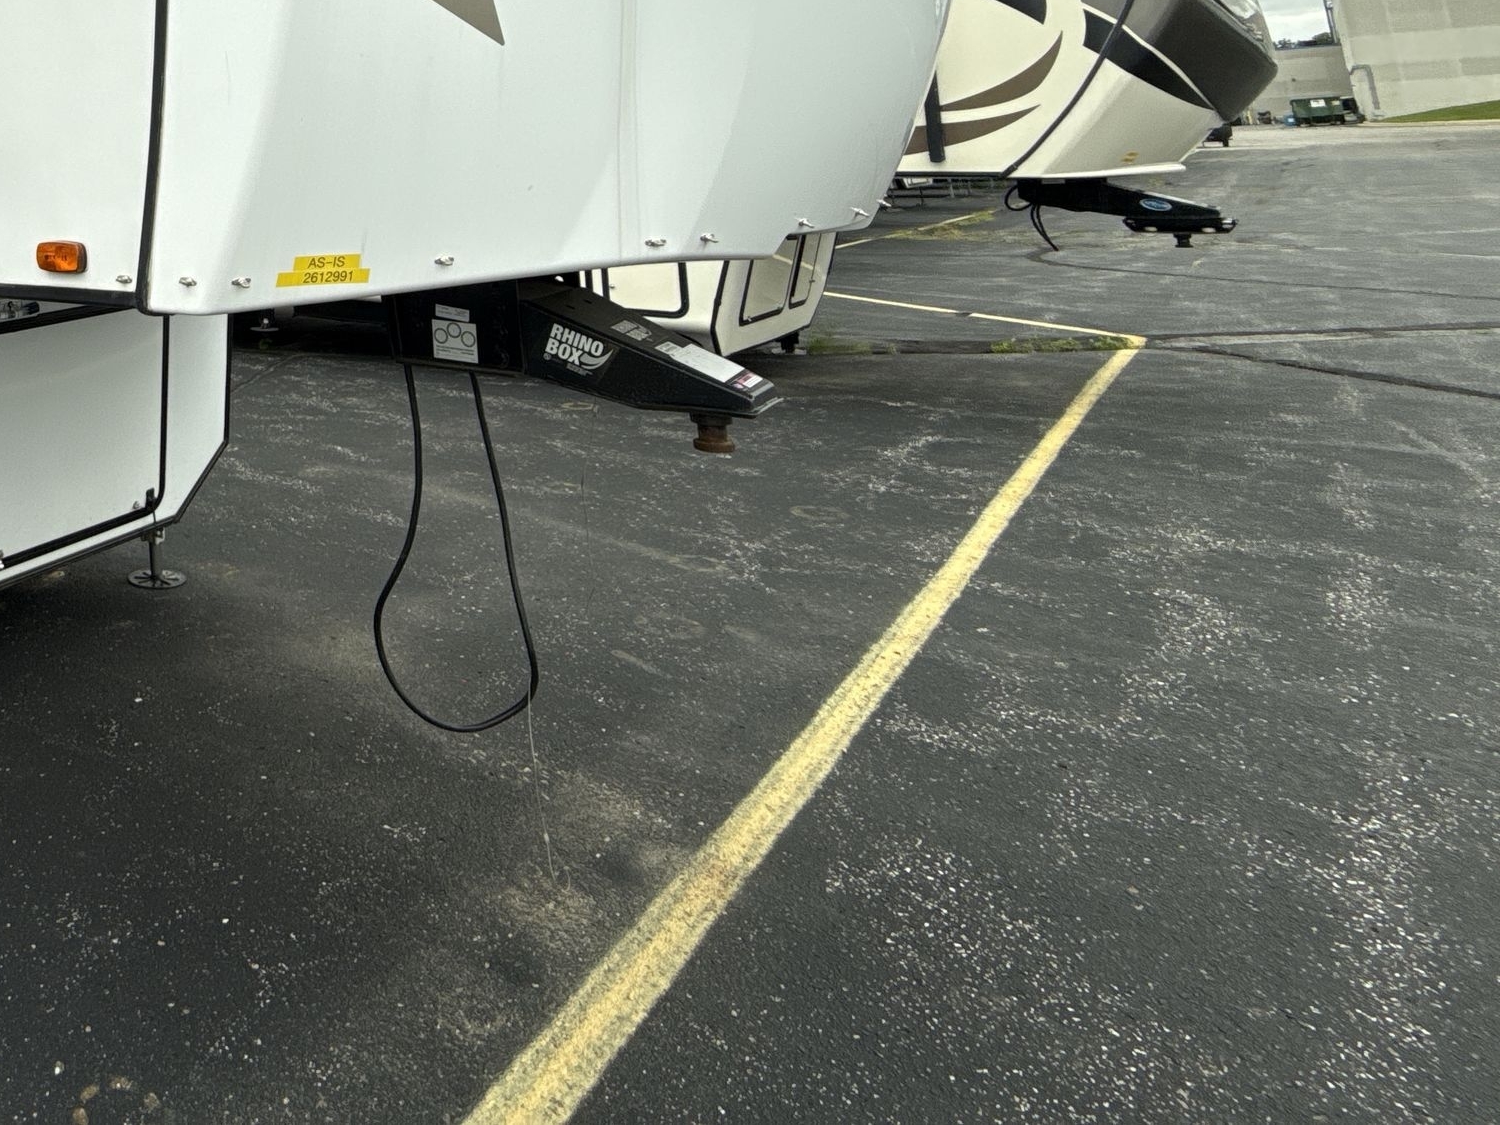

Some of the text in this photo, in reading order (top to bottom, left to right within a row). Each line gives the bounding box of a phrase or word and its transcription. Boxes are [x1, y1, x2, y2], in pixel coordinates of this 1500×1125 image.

[307, 255, 346, 269] AS-IS
[302, 270, 354, 284] 2612991
[549, 322, 604, 357] RHINO
[544, 337, 583, 366] BOX
